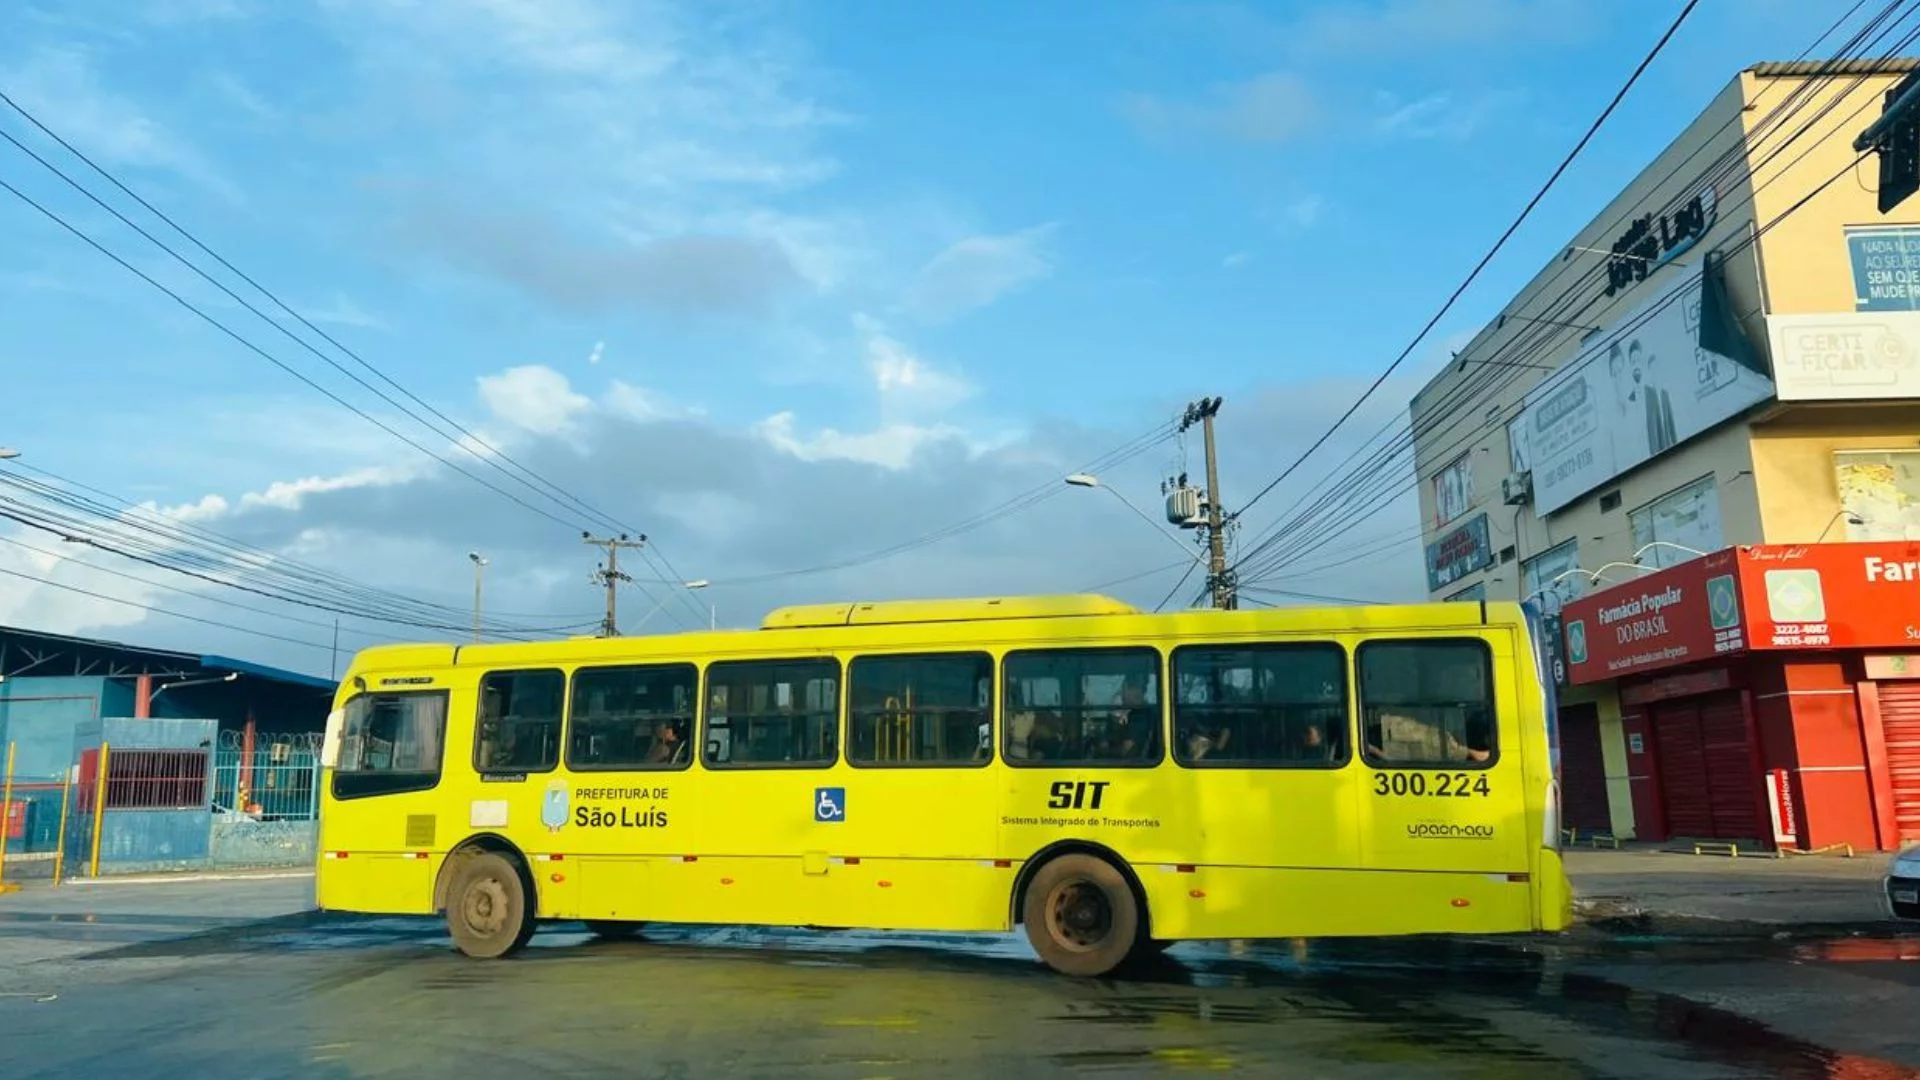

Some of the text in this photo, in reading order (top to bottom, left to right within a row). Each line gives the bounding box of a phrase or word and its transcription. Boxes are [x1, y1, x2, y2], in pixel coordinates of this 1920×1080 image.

[1866, 255, 1882, 269] AO
[1867, 270, 1920, 285] SEM QUE
[1870, 284, 1907, 298] MUDE
[1799, 333, 1864, 352] CERTI
[1802, 352, 1868, 372] FICAR
[1599, 586, 1683, 625] Farmácia Popular
[1617, 616, 1669, 645] DO BRASIL
[575, 788, 669, 799] PREFEITURA DE
[1374, 772, 1490, 797] 300.224
[1048, 781, 1110, 810] SIT
[575, 805, 668, 827] São Luís
[1002, 816, 1160, 828] Sistema Integrado de Transportes
